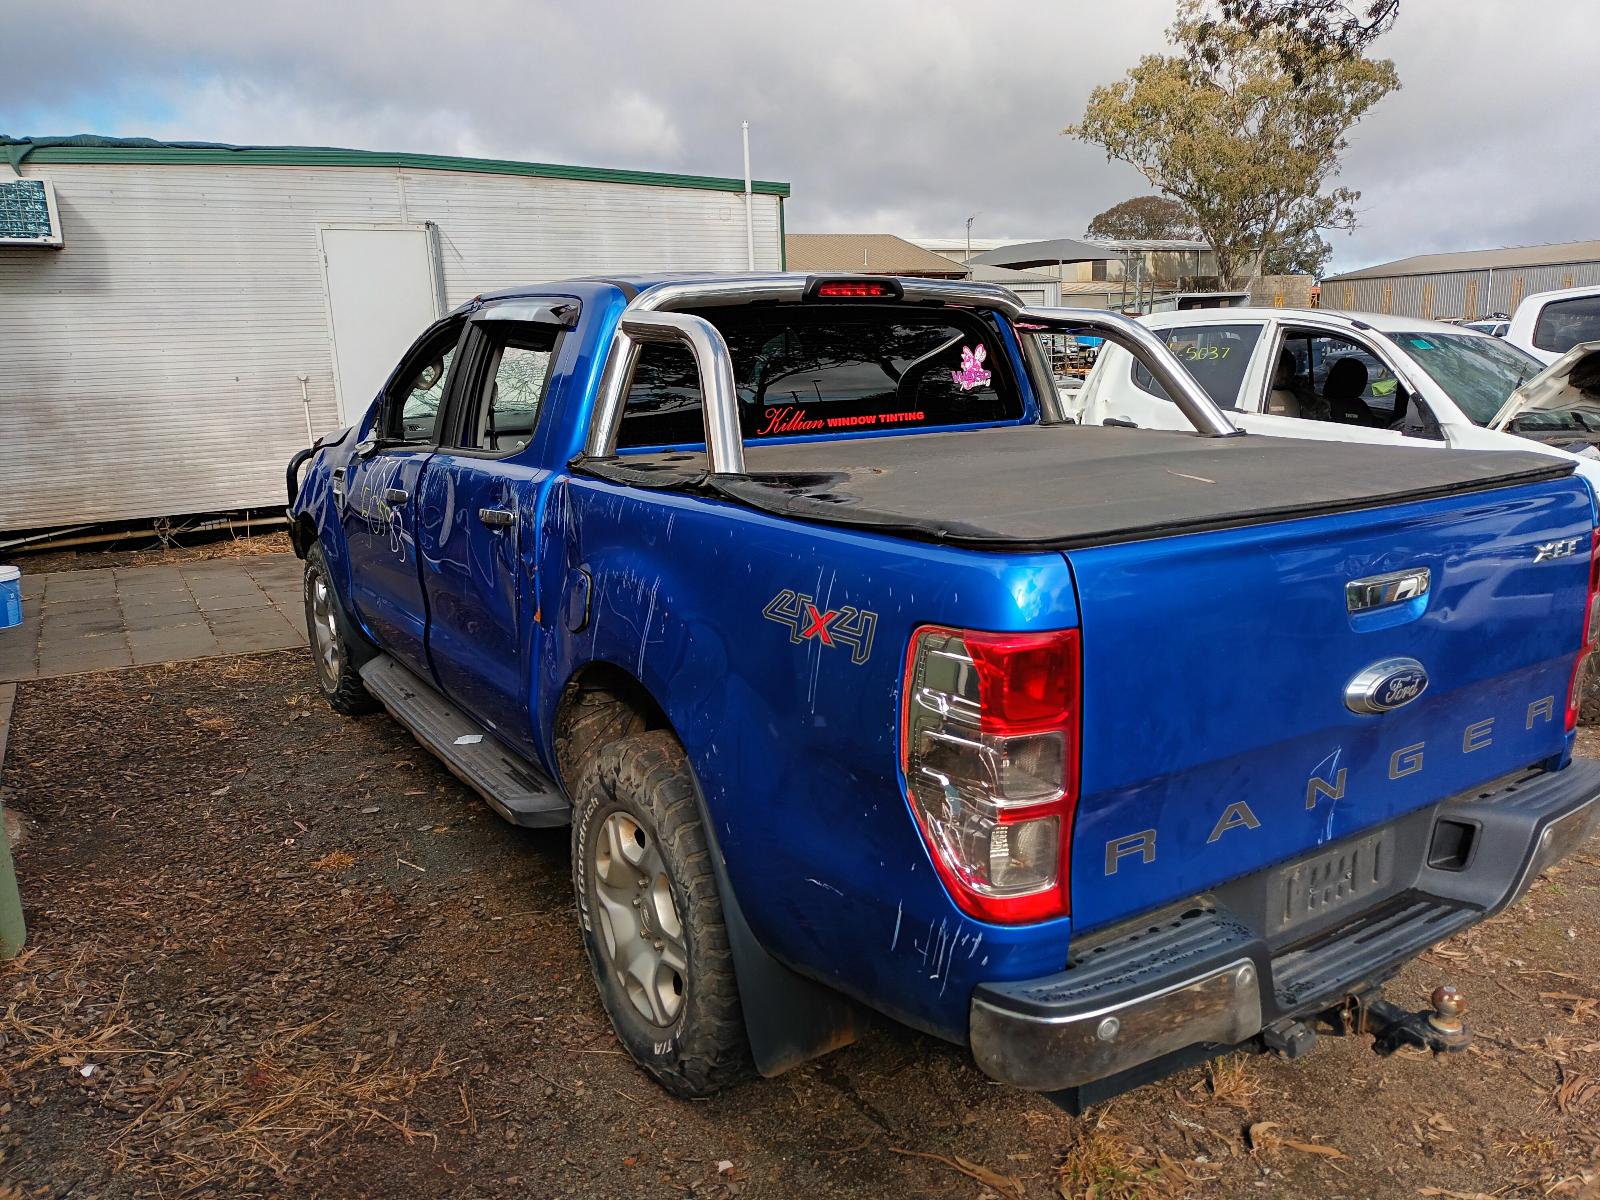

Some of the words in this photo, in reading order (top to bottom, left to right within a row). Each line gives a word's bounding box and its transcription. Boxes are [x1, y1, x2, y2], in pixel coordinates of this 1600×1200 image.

[757, 407, 825, 435] Killian
[827, 415, 876, 428] WINDOW
[879, 411, 925, 423] TINTING
[1385, 675, 1420, 704] Ford
[1104, 695, 1555, 876] RANGER
